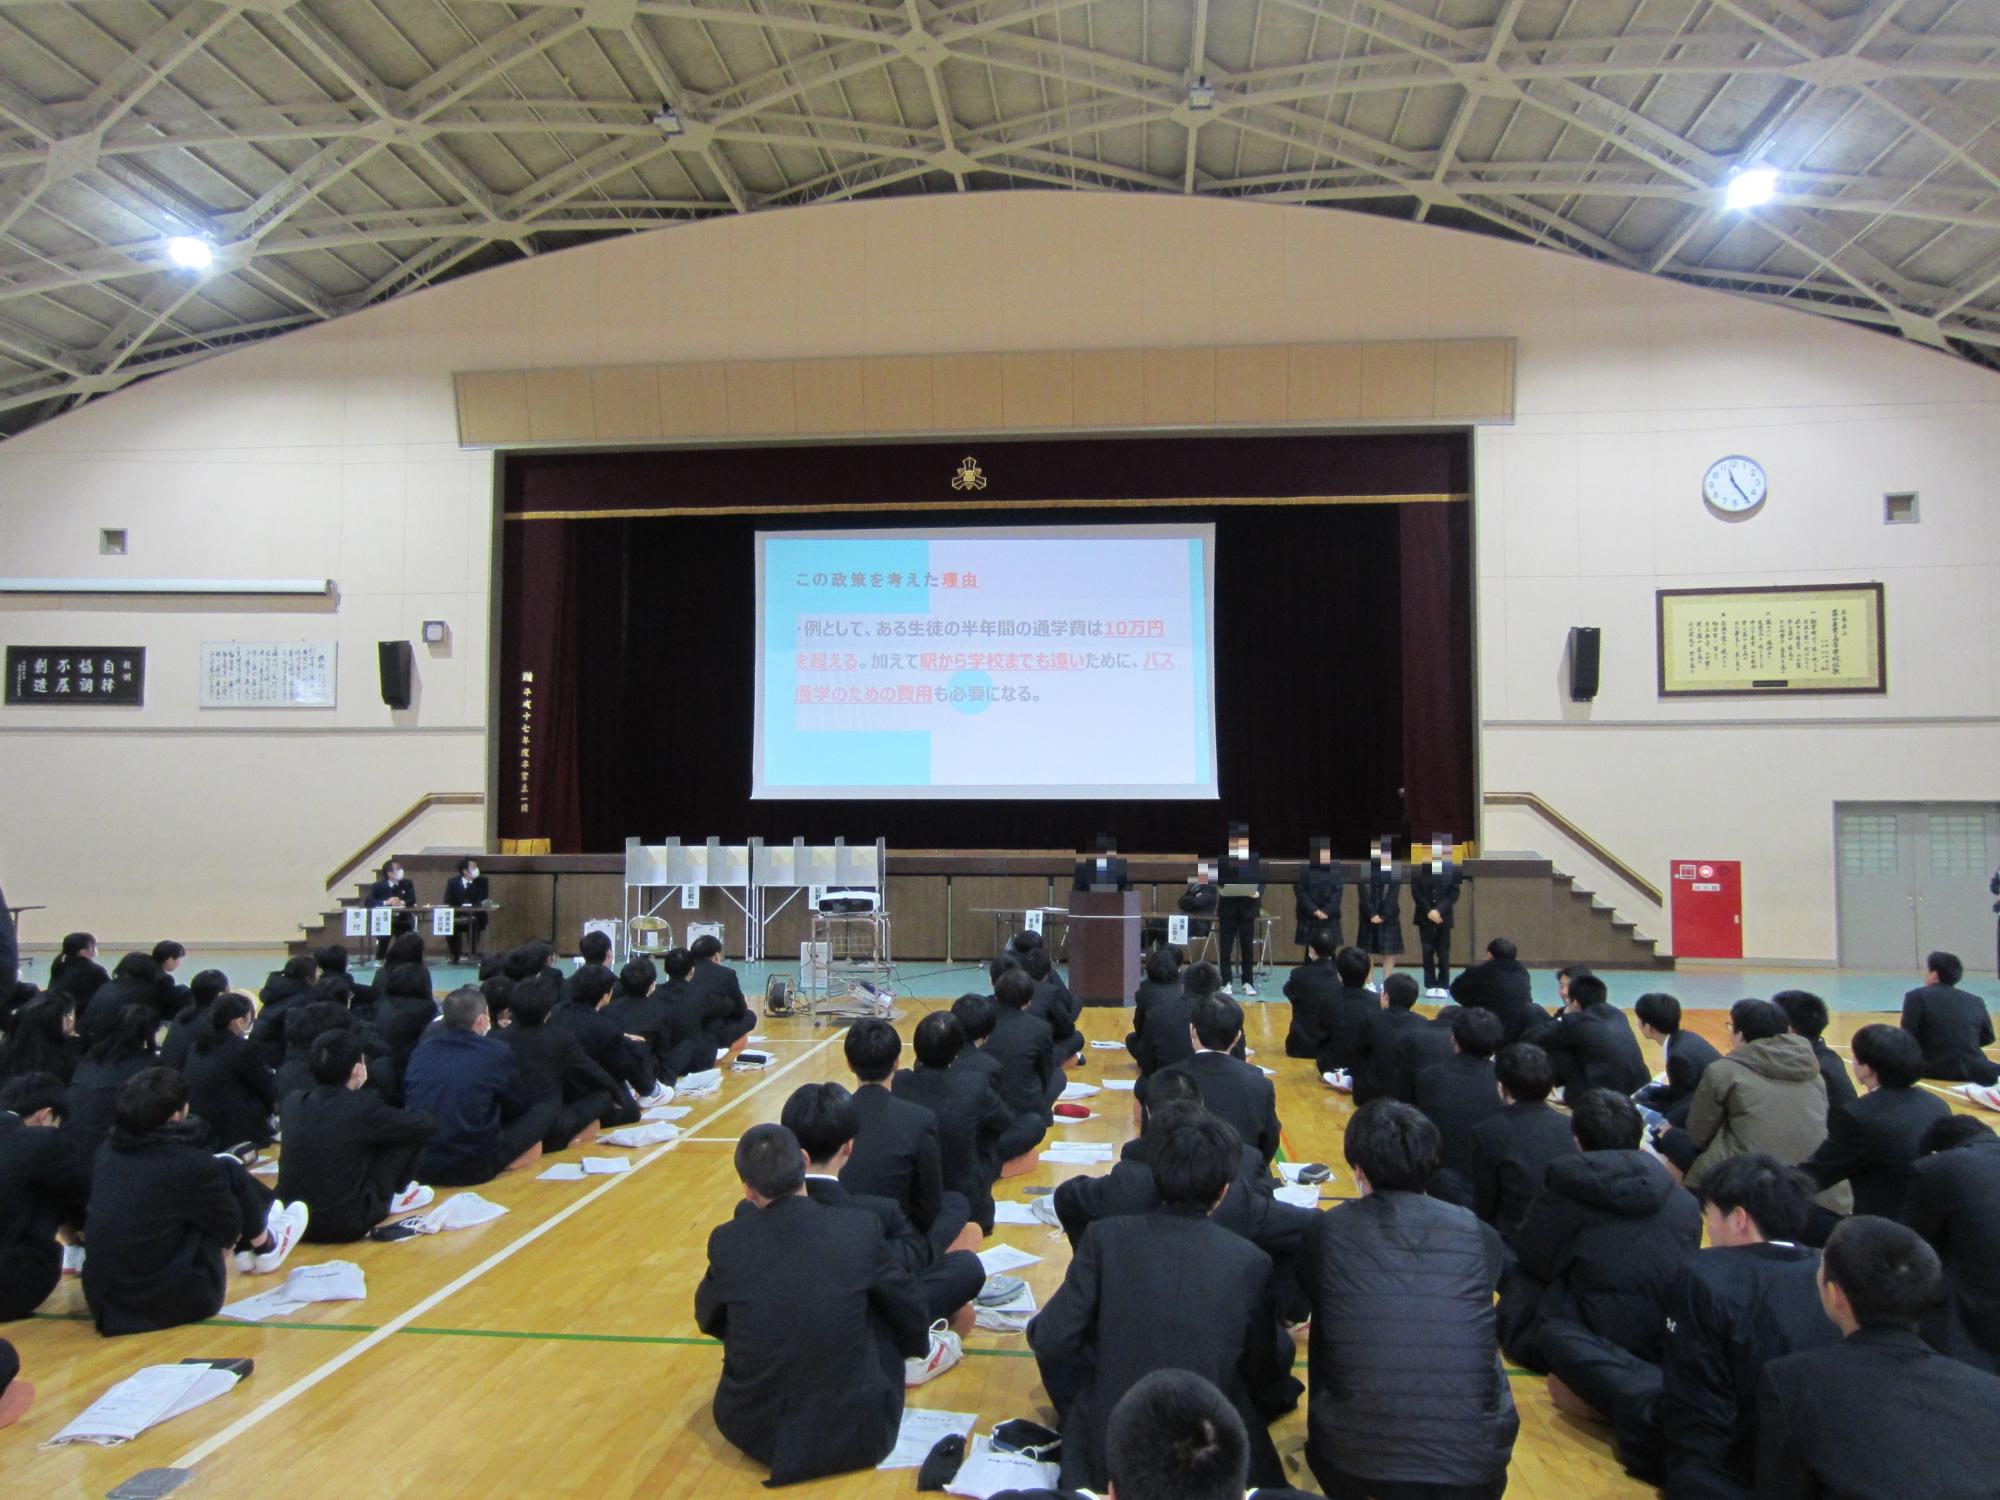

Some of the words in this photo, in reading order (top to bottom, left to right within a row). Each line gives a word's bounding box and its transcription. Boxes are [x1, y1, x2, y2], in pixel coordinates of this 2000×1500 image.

[796, 571, 979, 588] この政策を考えた理由
